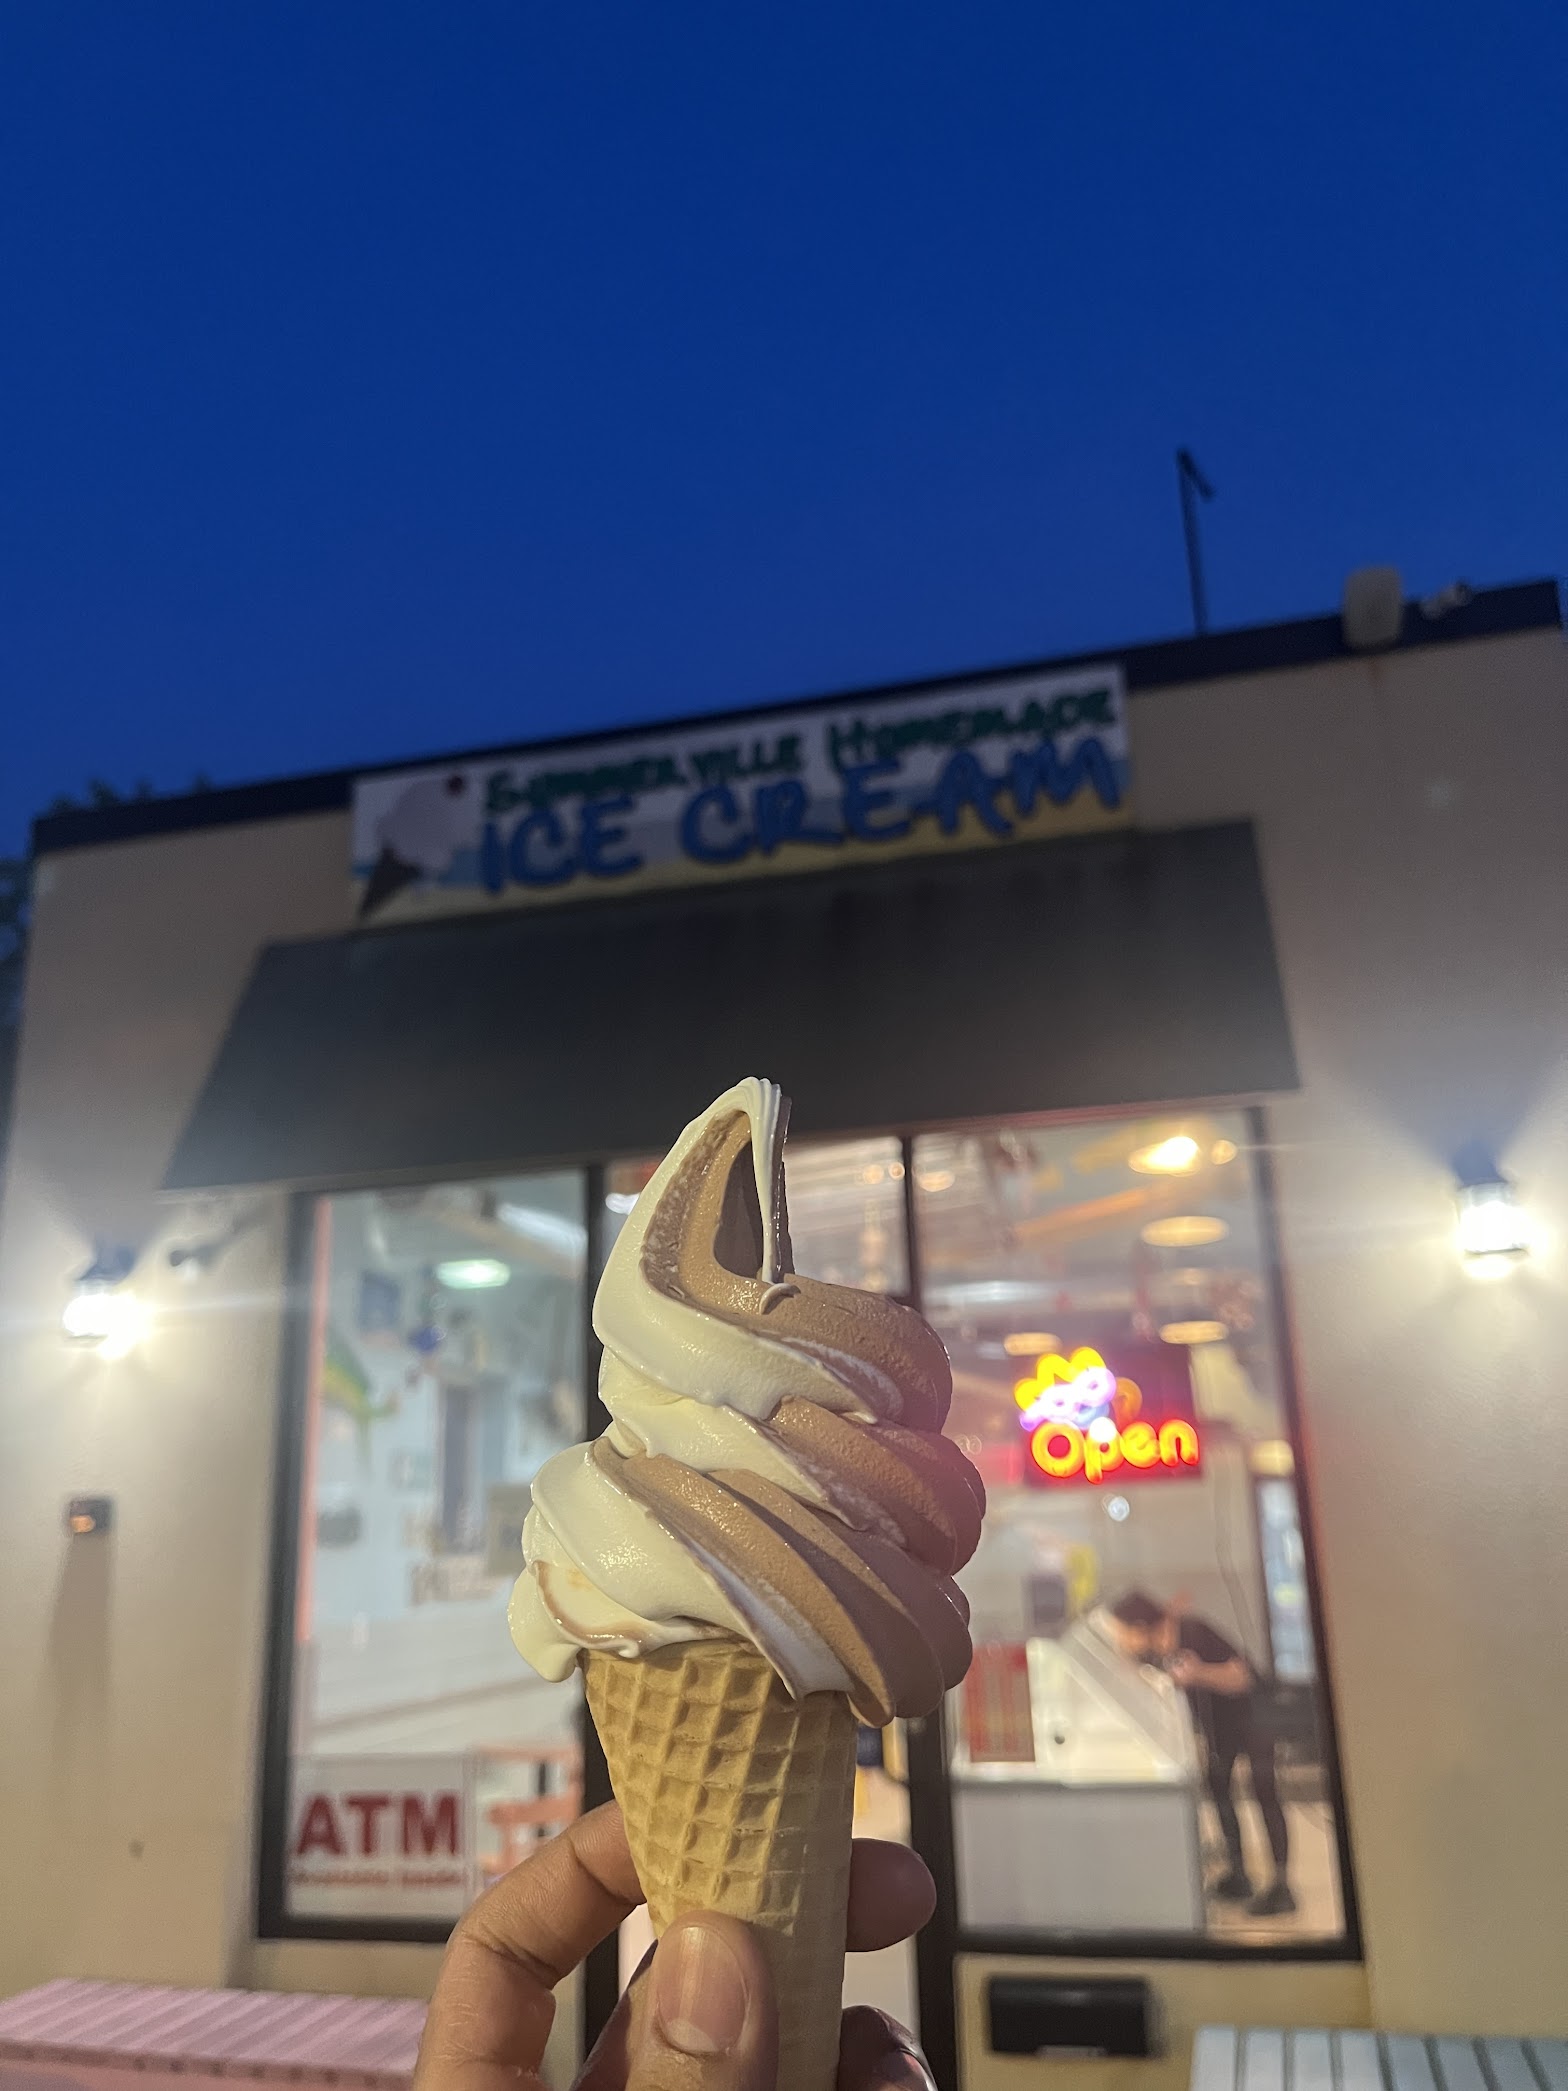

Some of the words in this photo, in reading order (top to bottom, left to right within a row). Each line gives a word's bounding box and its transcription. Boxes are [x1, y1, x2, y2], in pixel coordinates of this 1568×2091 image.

[480, 796, 643, 895] ICE
[679, 737, 1121, 865] CREAM
[1031, 1418, 1199, 1485] Open
[297, 1791, 458, 1856] ATM
